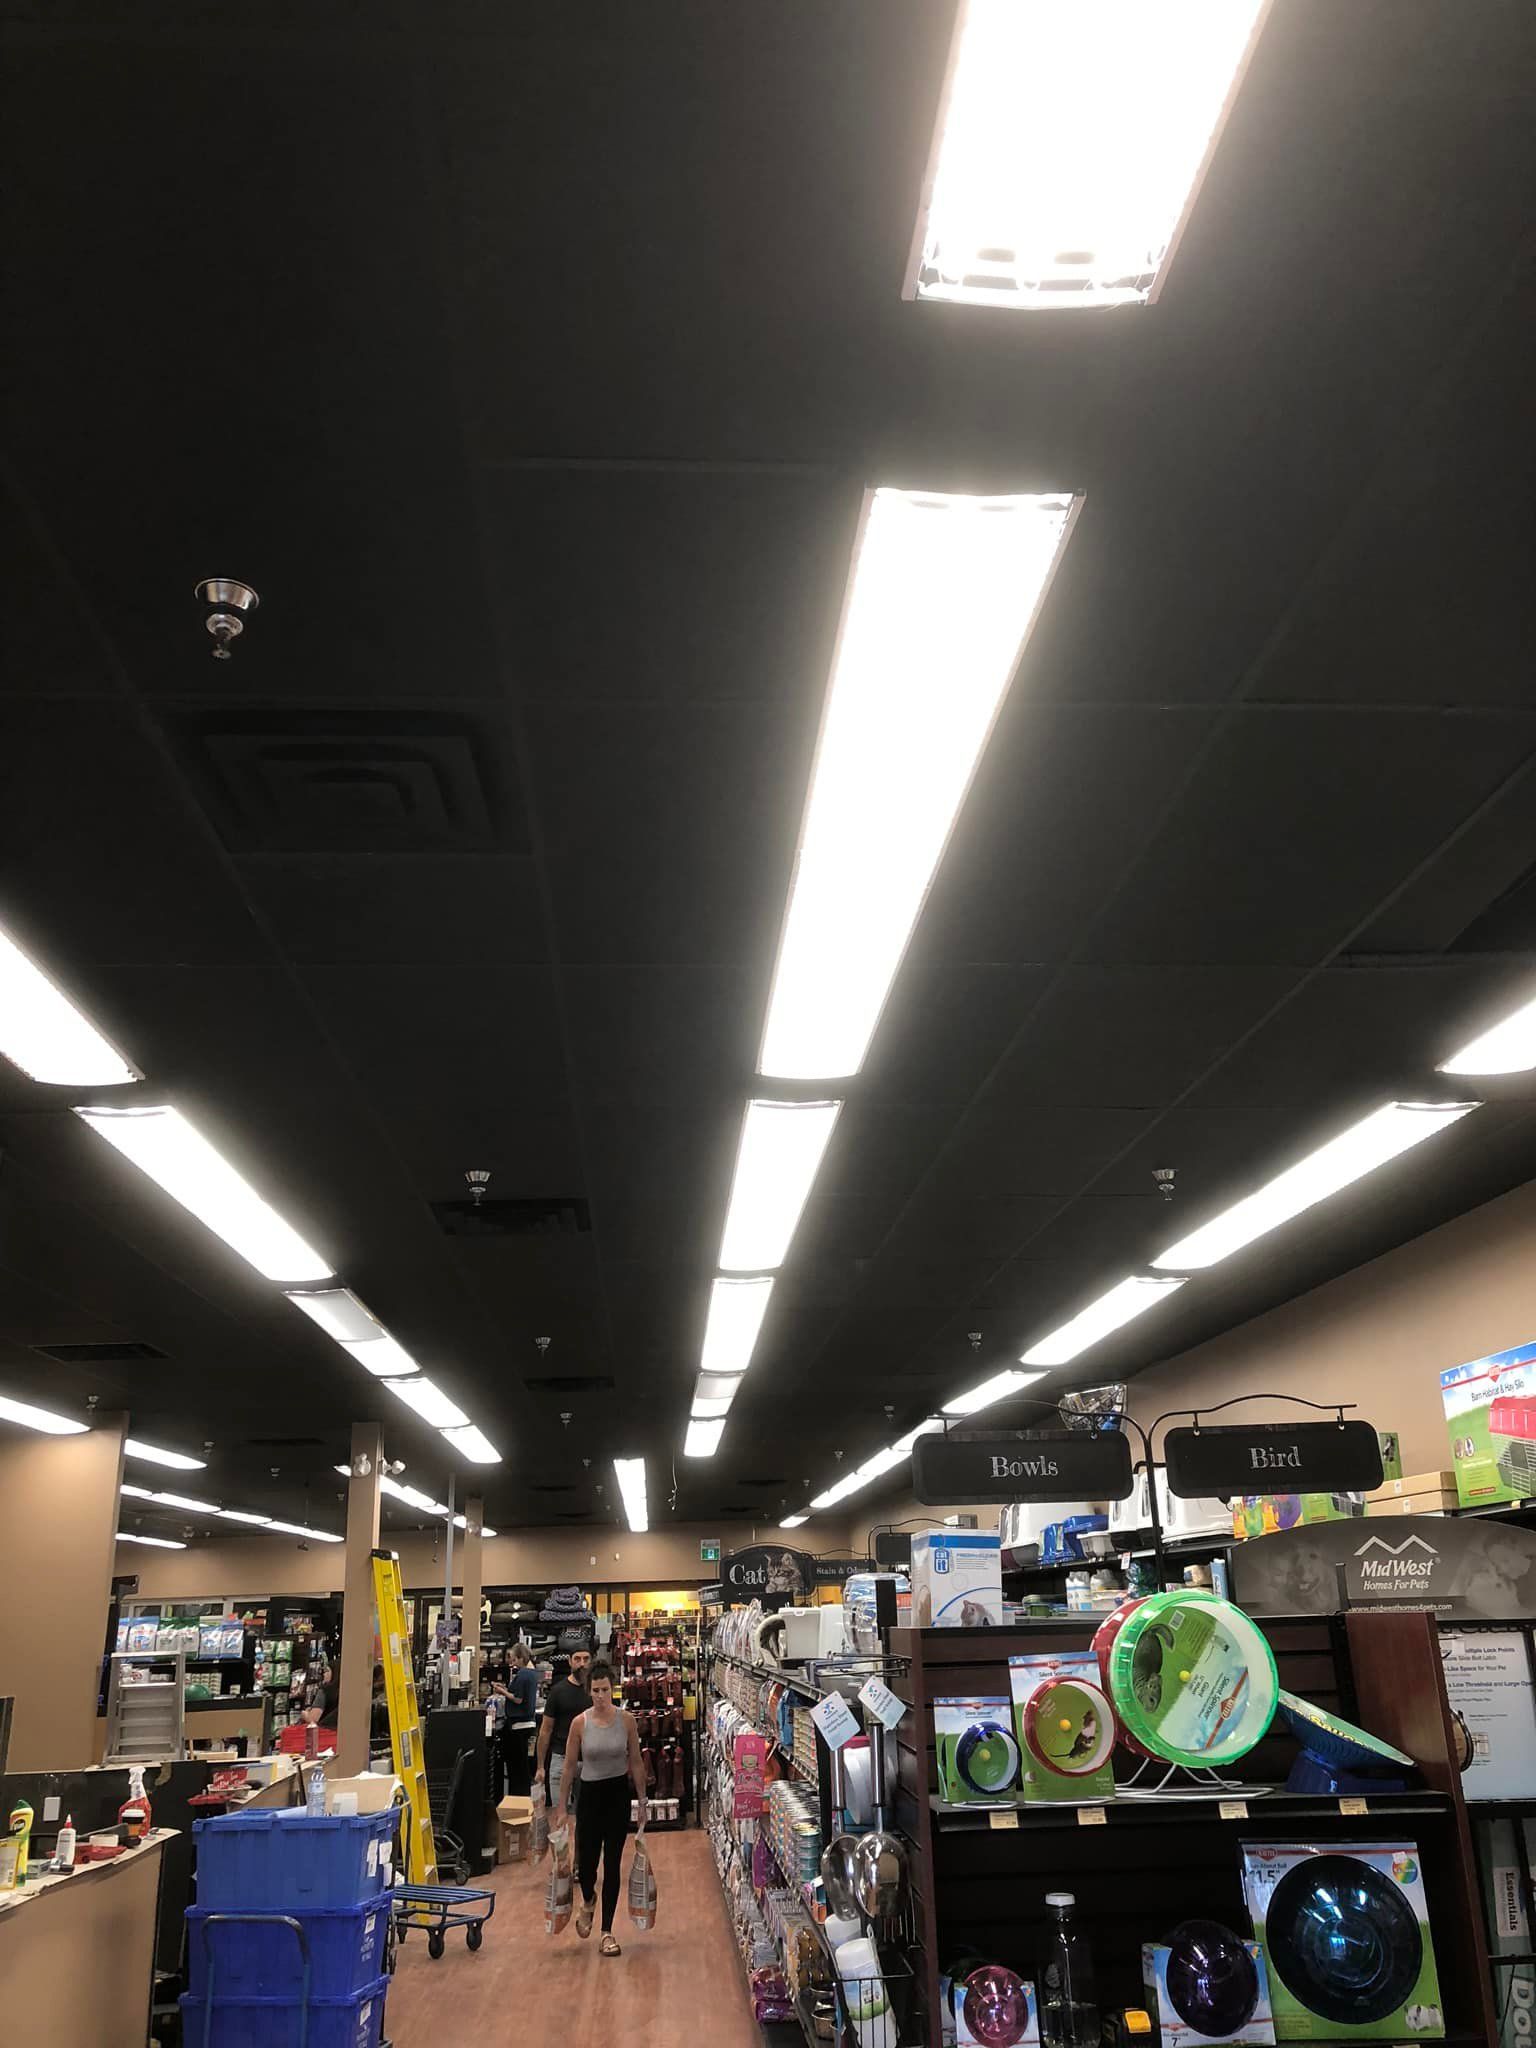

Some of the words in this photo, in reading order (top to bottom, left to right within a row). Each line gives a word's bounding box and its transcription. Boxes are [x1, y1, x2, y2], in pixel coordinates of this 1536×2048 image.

[990, 1455, 1059, 1478] Bowls
[1249, 1446, 1303, 1469] Bird
[729, 1563, 766, 1585] Cat
[1360, 1559, 1435, 1578] MidWest
[1363, 1581, 1393, 1591] Homes
[1394, 1580, 1410, 1591] For
[1410, 1579, 1429, 1589] Pets
[1506, 1872, 1518, 1931] Essentials
